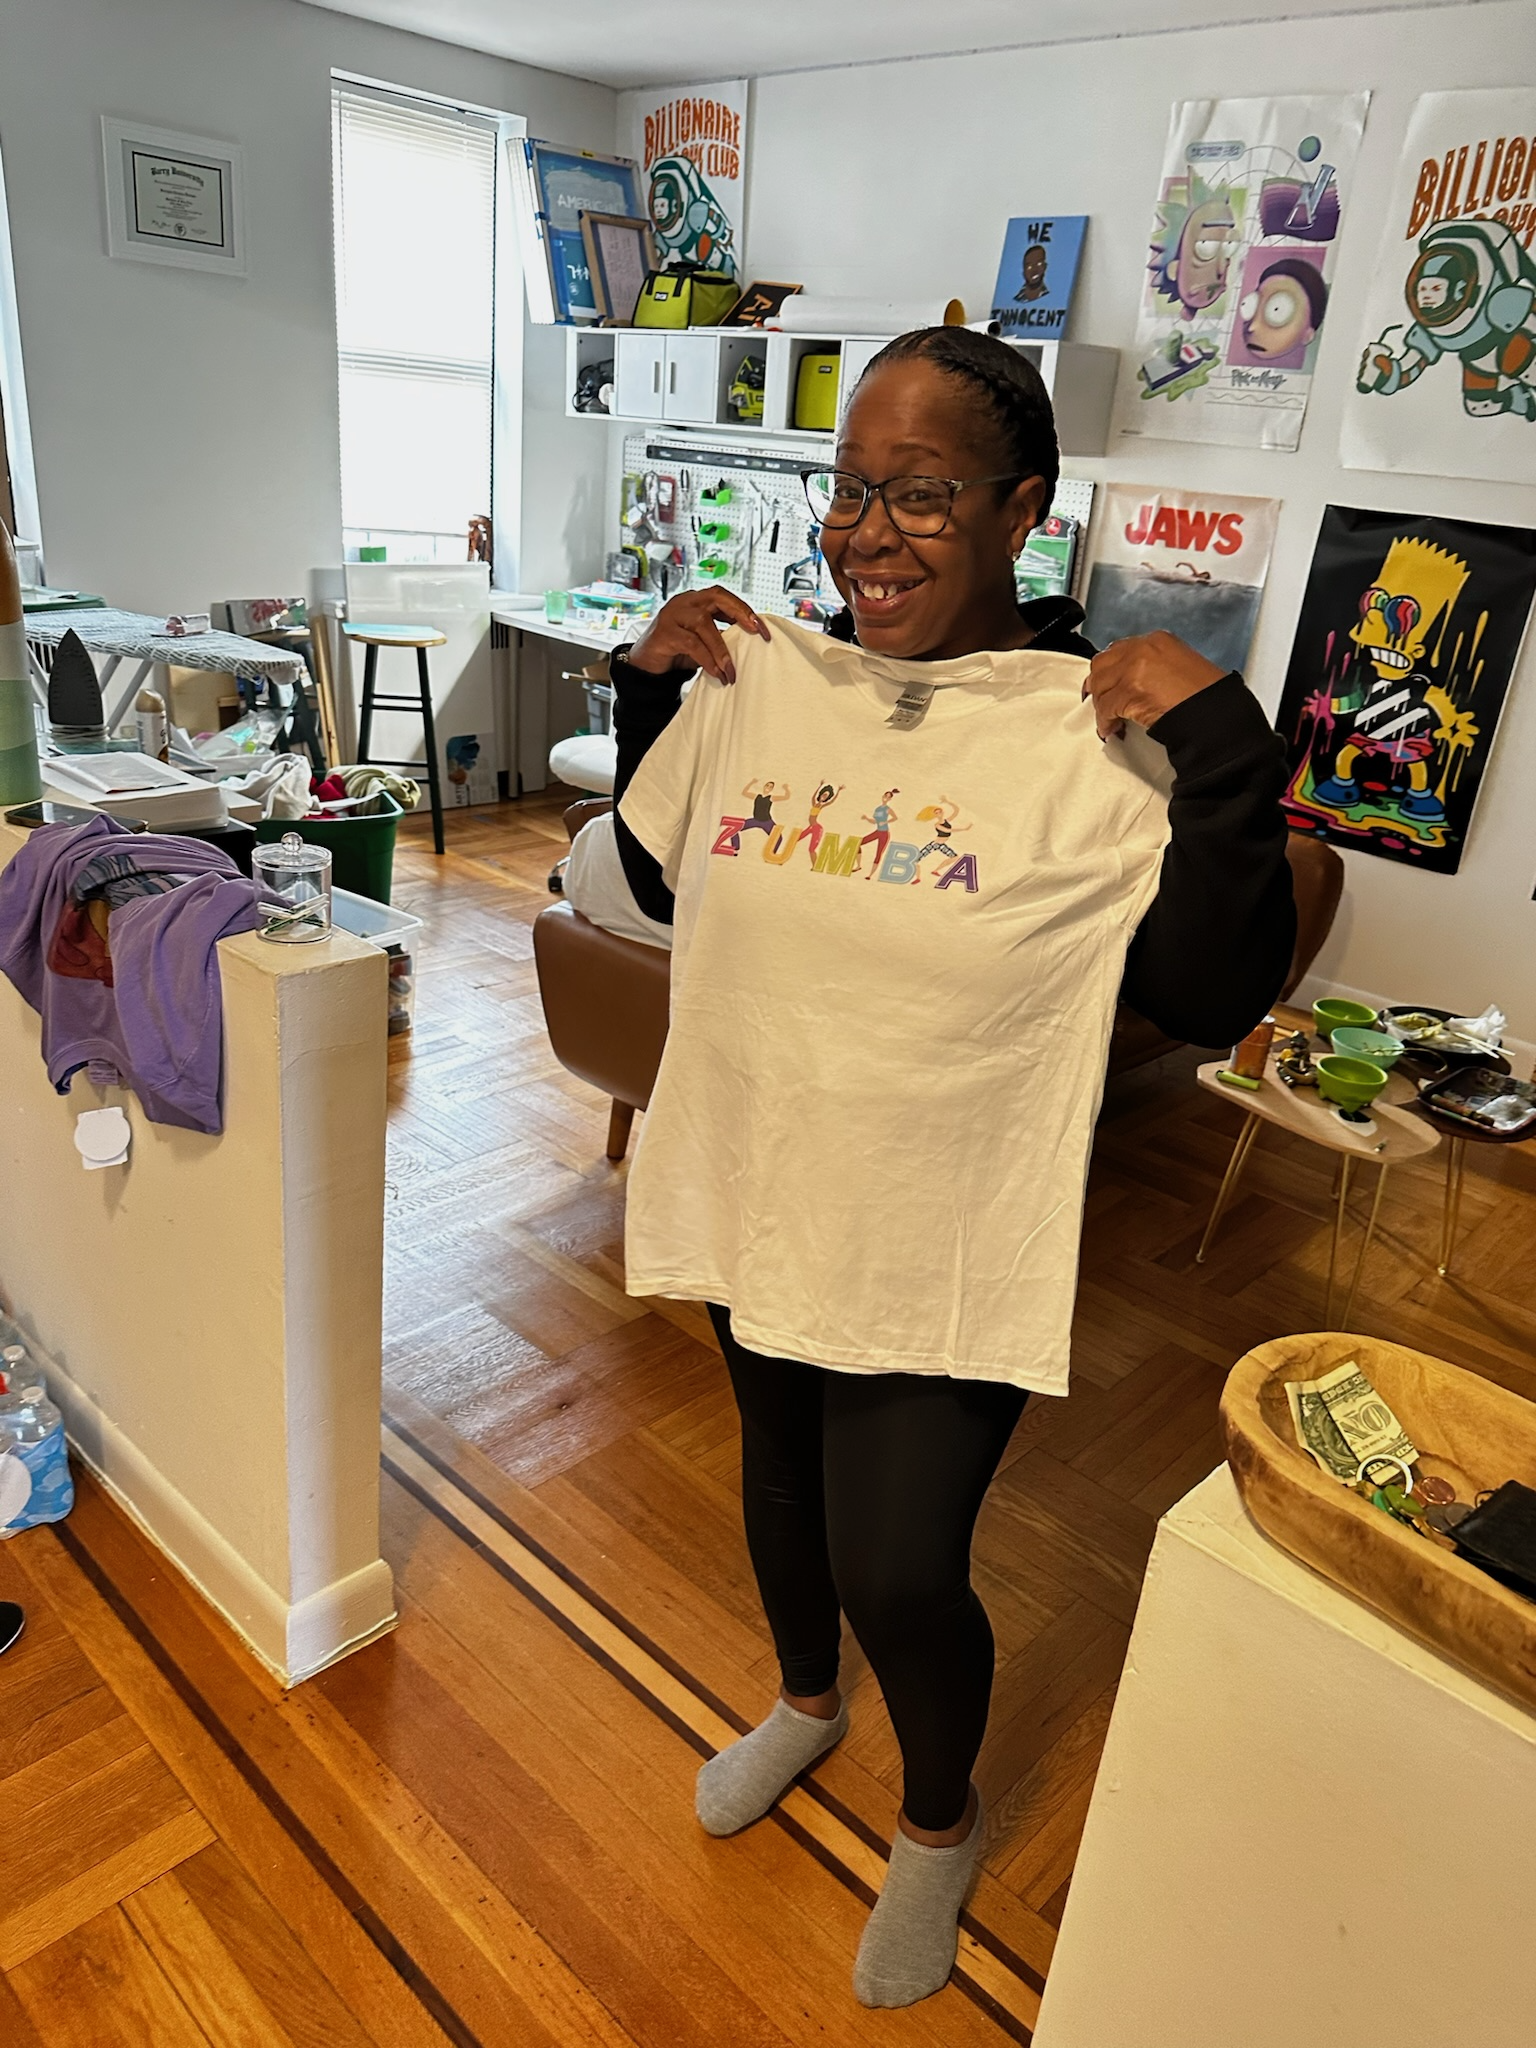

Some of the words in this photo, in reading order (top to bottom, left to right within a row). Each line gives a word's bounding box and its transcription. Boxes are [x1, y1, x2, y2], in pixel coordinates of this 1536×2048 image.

[644, 98, 741, 173] BILLIONAIRE
[707, 144, 740, 180] CLUB
[1027, 222, 1053, 243] HE
[990, 308, 1067, 327] INNOCENT
[1124, 505, 1244, 555] JAWS
[710, 815, 979, 893] ZUMBA
